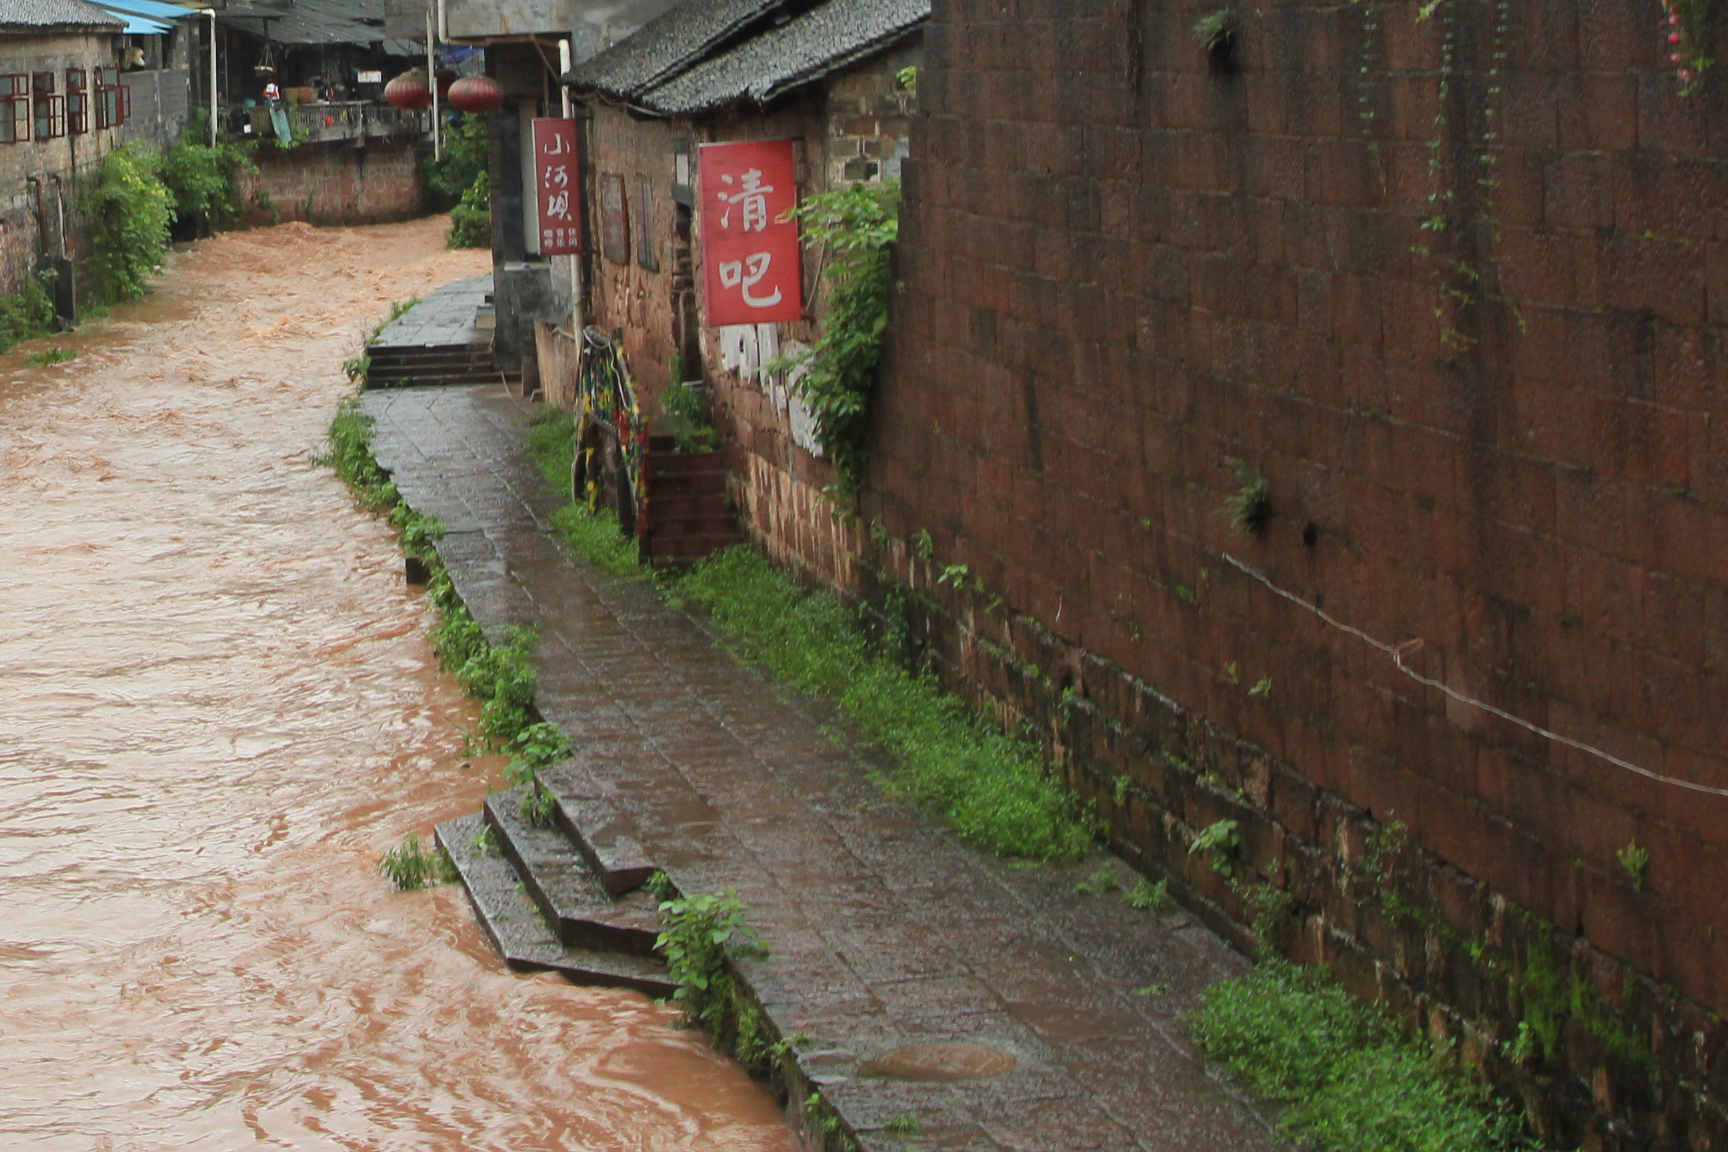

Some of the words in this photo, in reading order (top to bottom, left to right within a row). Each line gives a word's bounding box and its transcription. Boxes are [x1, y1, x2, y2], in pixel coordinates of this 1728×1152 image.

[544, 132, 572, 222] 小河坝
[717, 167, 783, 309] 清吧
